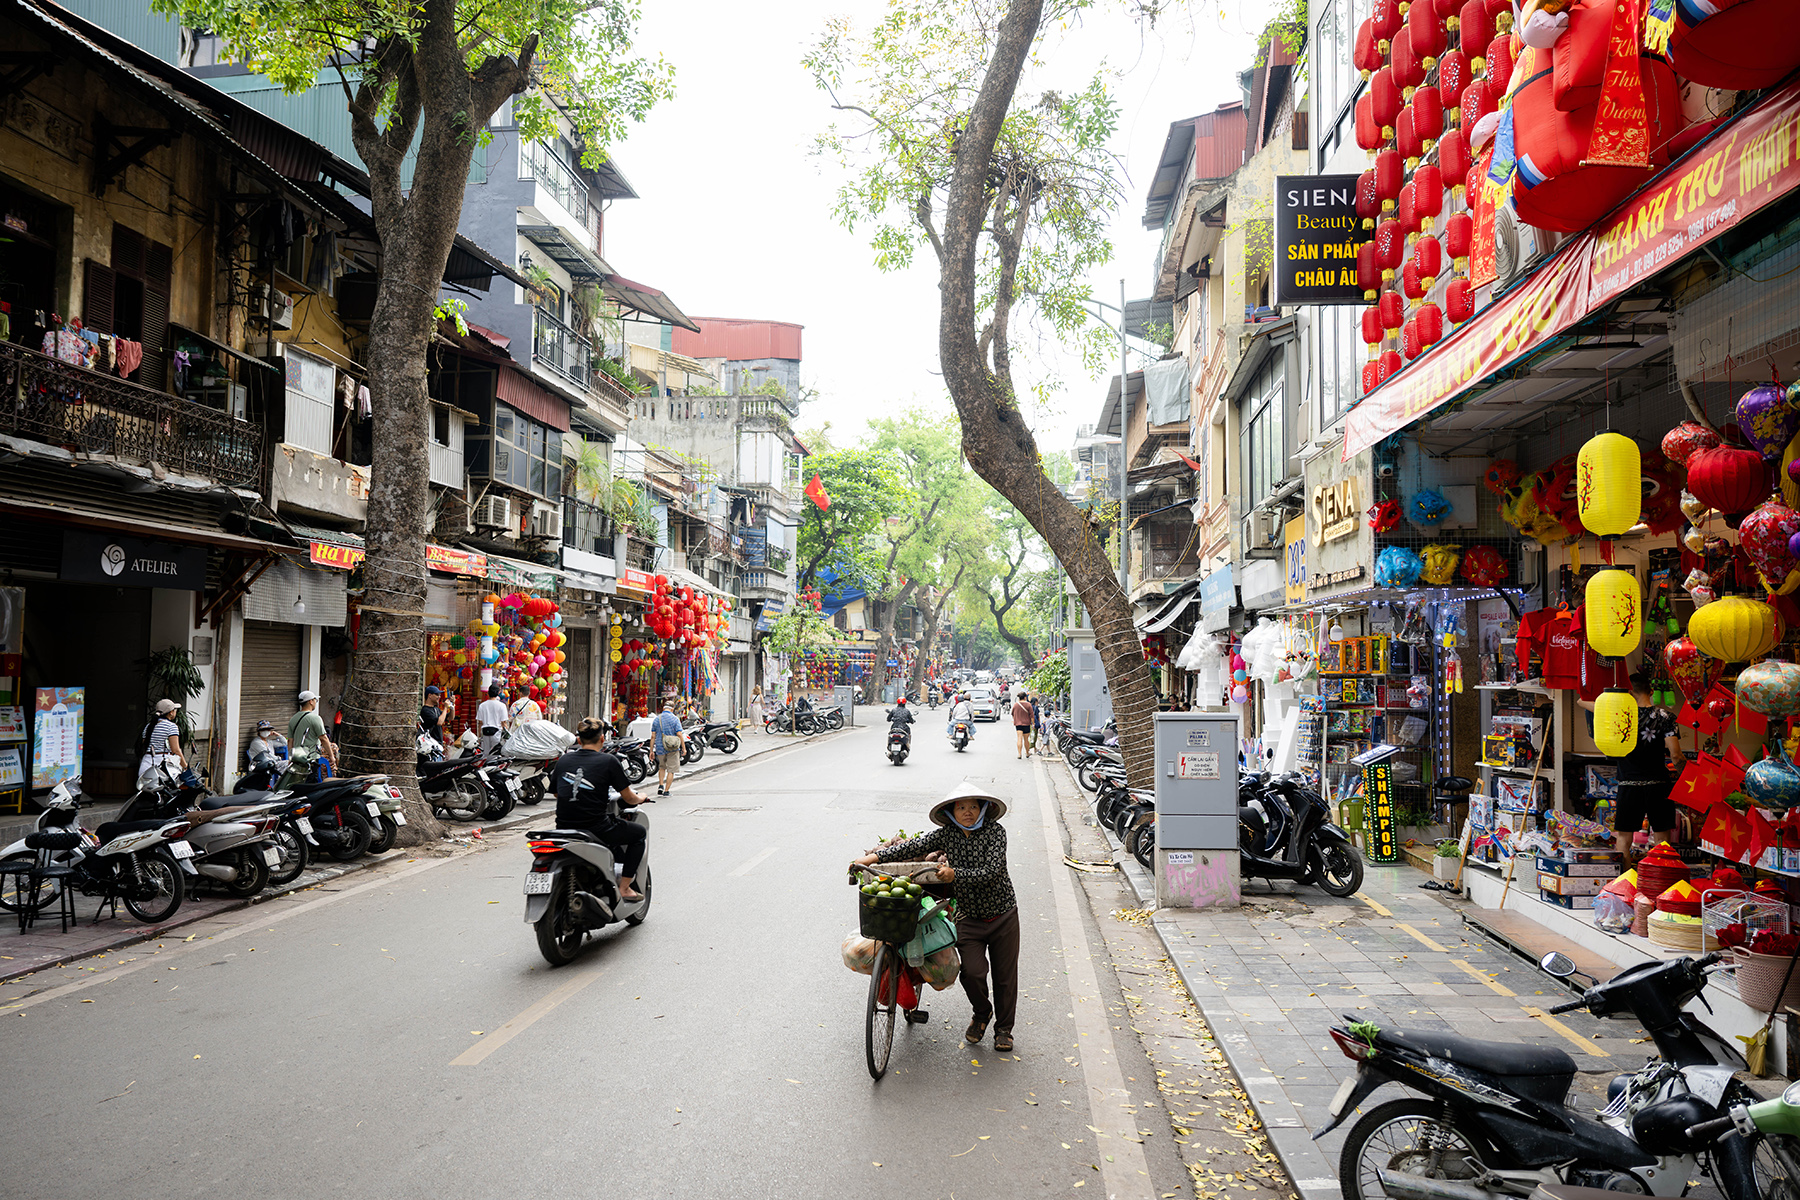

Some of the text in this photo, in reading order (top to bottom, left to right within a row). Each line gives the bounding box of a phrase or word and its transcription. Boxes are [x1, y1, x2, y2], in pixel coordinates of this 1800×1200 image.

[1297, 213, 1357, 232] Beauty
[1594, 187, 1672, 274] THANH
[1674, 132, 1737, 221] THƯ
[1287, 239, 1318, 260] SẢN
[1655, 242, 1667, 265] 229
[1688, 222, 1704, 243] 0969
[1706, 213, 1719, 232] 157
[1295, 267, 1335, 287] CHÂU
[1402, 330, 1485, 418] THANH
[1312, 476, 1359, 548] SIENA
[131, 558, 178, 575] ATELIER
[1487, 612, 1498, 621] SALE
[1362, 768, 1374, 857] MASSAGE
[1376, 767, 1392, 857] SHAMPOO
